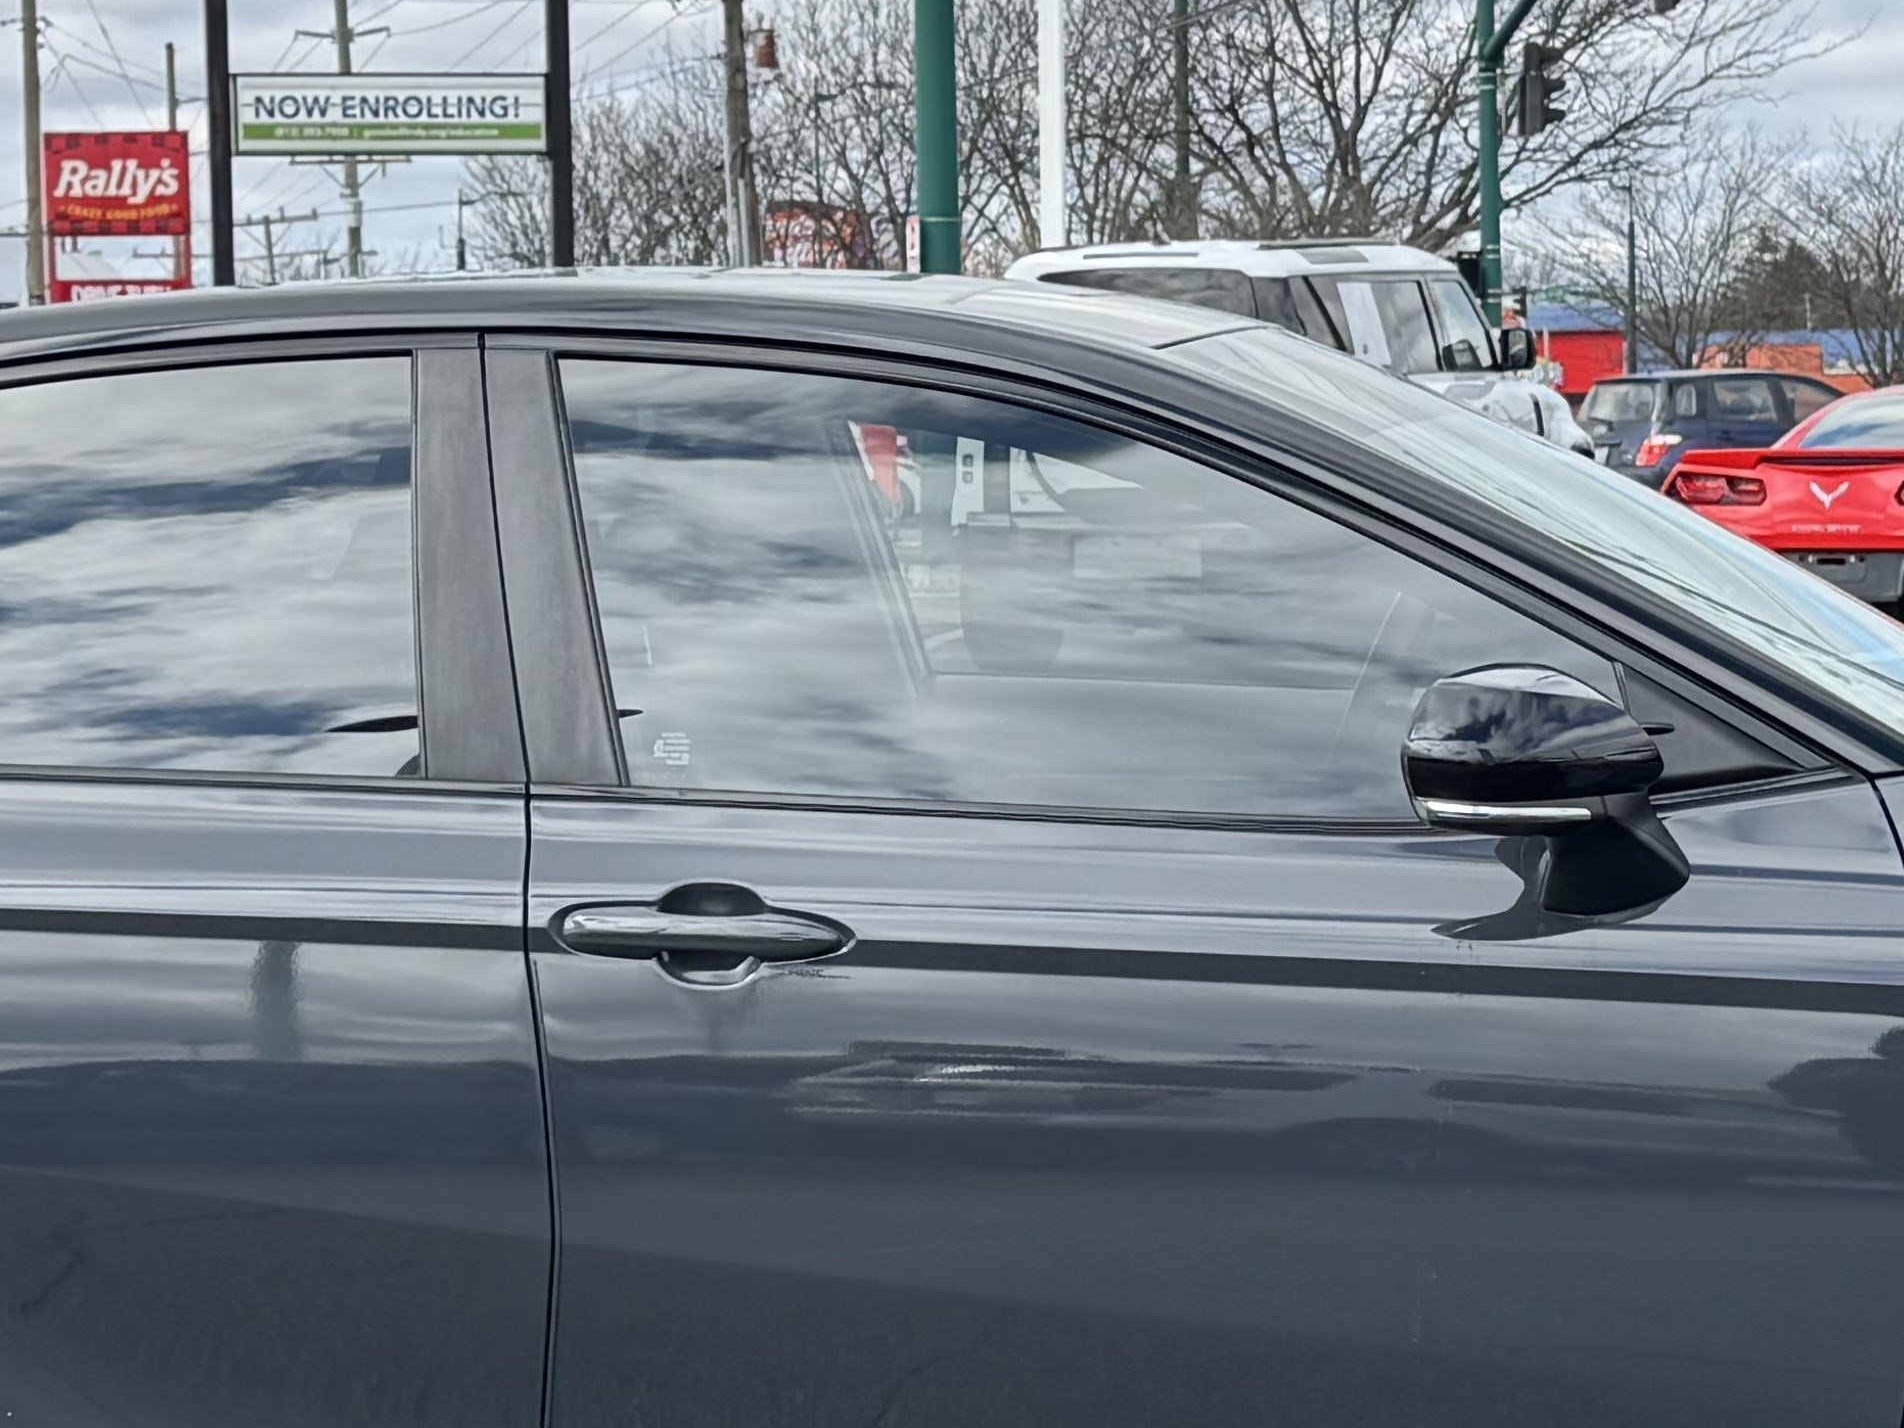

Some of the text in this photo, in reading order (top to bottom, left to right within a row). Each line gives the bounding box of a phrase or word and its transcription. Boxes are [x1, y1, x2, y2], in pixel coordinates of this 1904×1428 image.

[254, 95, 520, 119] NOW ENROLLING!
[53, 158, 179, 204] Rally's
